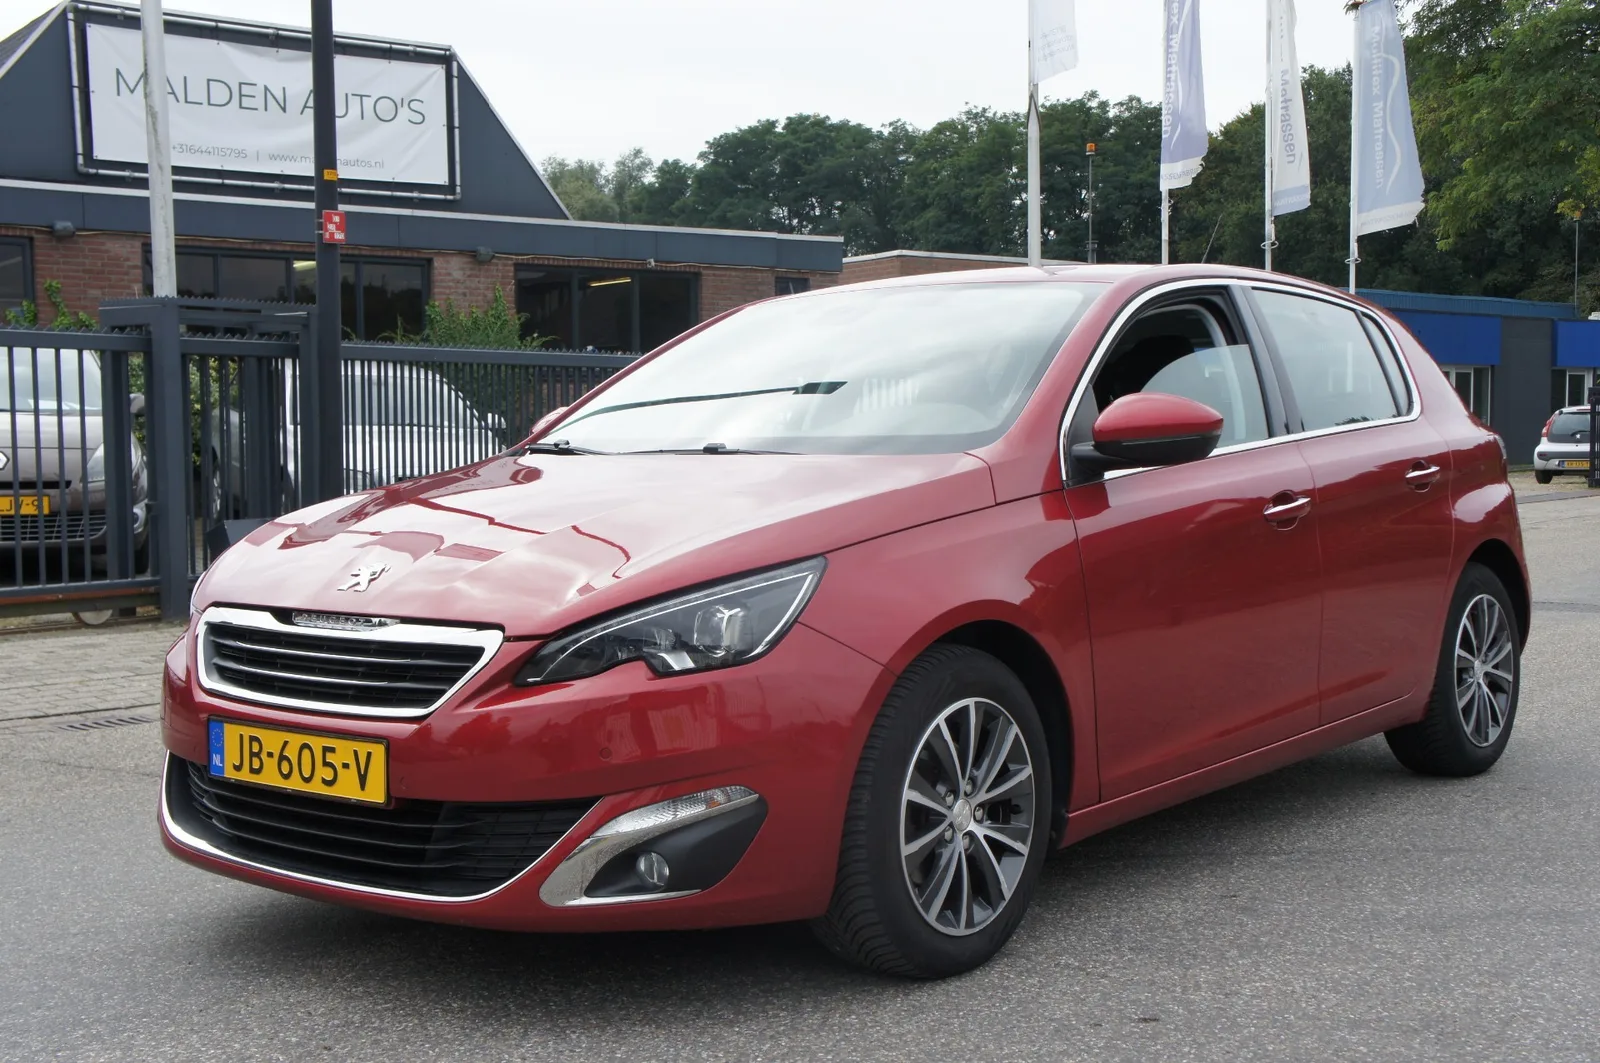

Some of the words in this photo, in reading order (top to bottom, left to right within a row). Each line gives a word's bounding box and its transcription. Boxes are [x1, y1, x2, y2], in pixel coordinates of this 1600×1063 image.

[1170, 0, 1179, 25] ex
[115, 67, 287, 114] MALDEN
[299, 88, 426, 125] AUTO'S
[1162, 33, 1179, 138] Matrassen
[1280, 69, 1297, 164] Matrassen
[1372, 101, 1385, 189] Matrassen
[172, 143, 248, 159] +31644115795
[268, 152, 385, 169] www.manautos.nl
[0, 498, 39, 512] J-9
[212, 753, 223, 767] NL
[232, 732, 373, 792] JB-605-V
